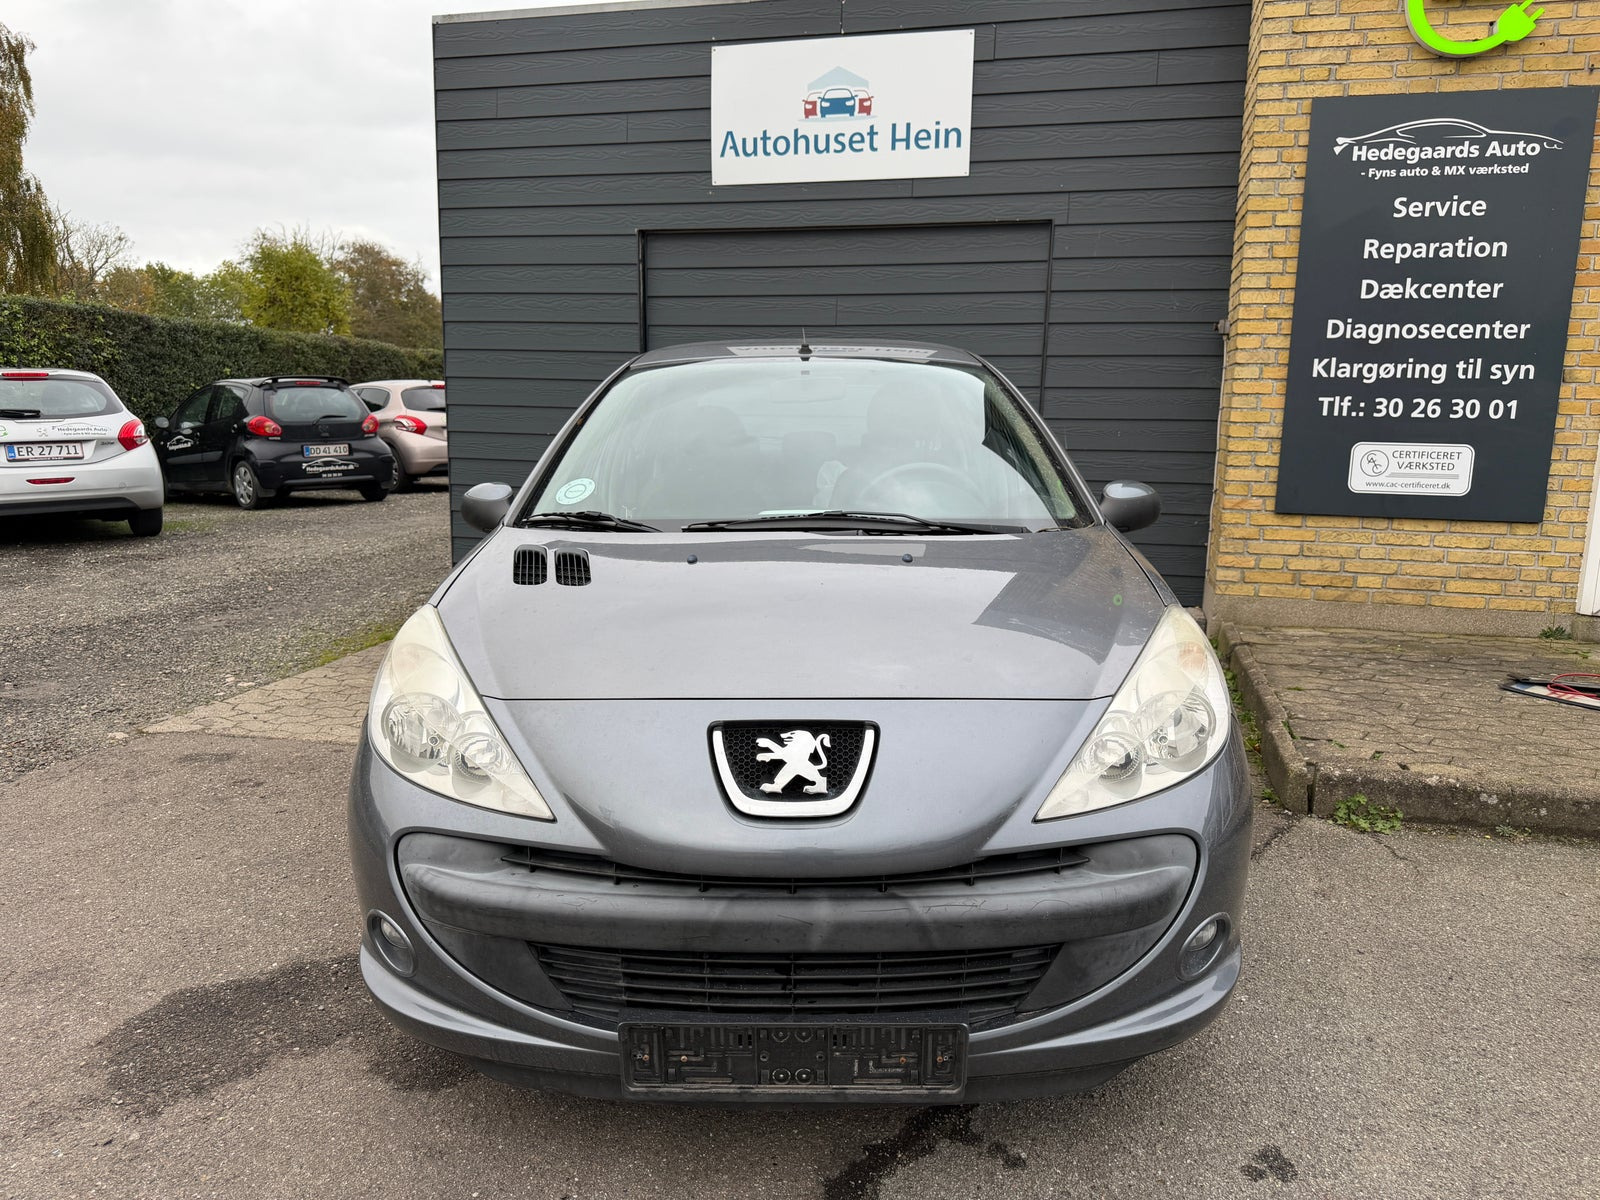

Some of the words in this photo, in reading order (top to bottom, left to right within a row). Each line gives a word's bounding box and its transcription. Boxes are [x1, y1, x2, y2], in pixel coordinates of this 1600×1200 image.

[720, 126, 878, 157] Autohuset
[891, 121, 961, 150] Hein
[1352, 141, 1480, 164] Hedegaards
[1485, 141, 1540, 156] Auto
[1369, 168, 1396, 179] Fyns
[1400, 167, 1428, 176] auto
[1432, 166, 1441, 175] &
[1444, 166, 1465, 175] MX
[1469, 163, 1529, 174] værksted
[1393, 195, 1486, 217] Service
[1364, 237, 1507, 263] Reparation
[1361, 278, 1503, 299] Dækcenter
[1327, 319, 1530, 344] Diagnosecenter
[1313, 358, 1447, 384] Klargøring
[1456, 358, 1482, 379] til
[1490, 364, 1534, 384] syn
[1319, 396, 1365, 416] Tlf.:
[1373, 398, 1403, 417] 30
[1411, 399, 1441, 418] 26
[1450, 399, 1480, 418] 30
[1489, 400, 1517, 419] 01
[17, 446, 35, 457] ER
[37, 445, 53, 456] 27
[56, 445, 80, 455] 711
[310, 447, 321, 455] DD
[322, 446, 331, 454] 41
[333, 446, 348, 454] 410
[1392, 450, 1462, 460] CERTIFICERET
[1397, 461, 1455, 471] VÆRKSTED
[1365, 481, 1451, 490] www.cac-certificeret.dk
